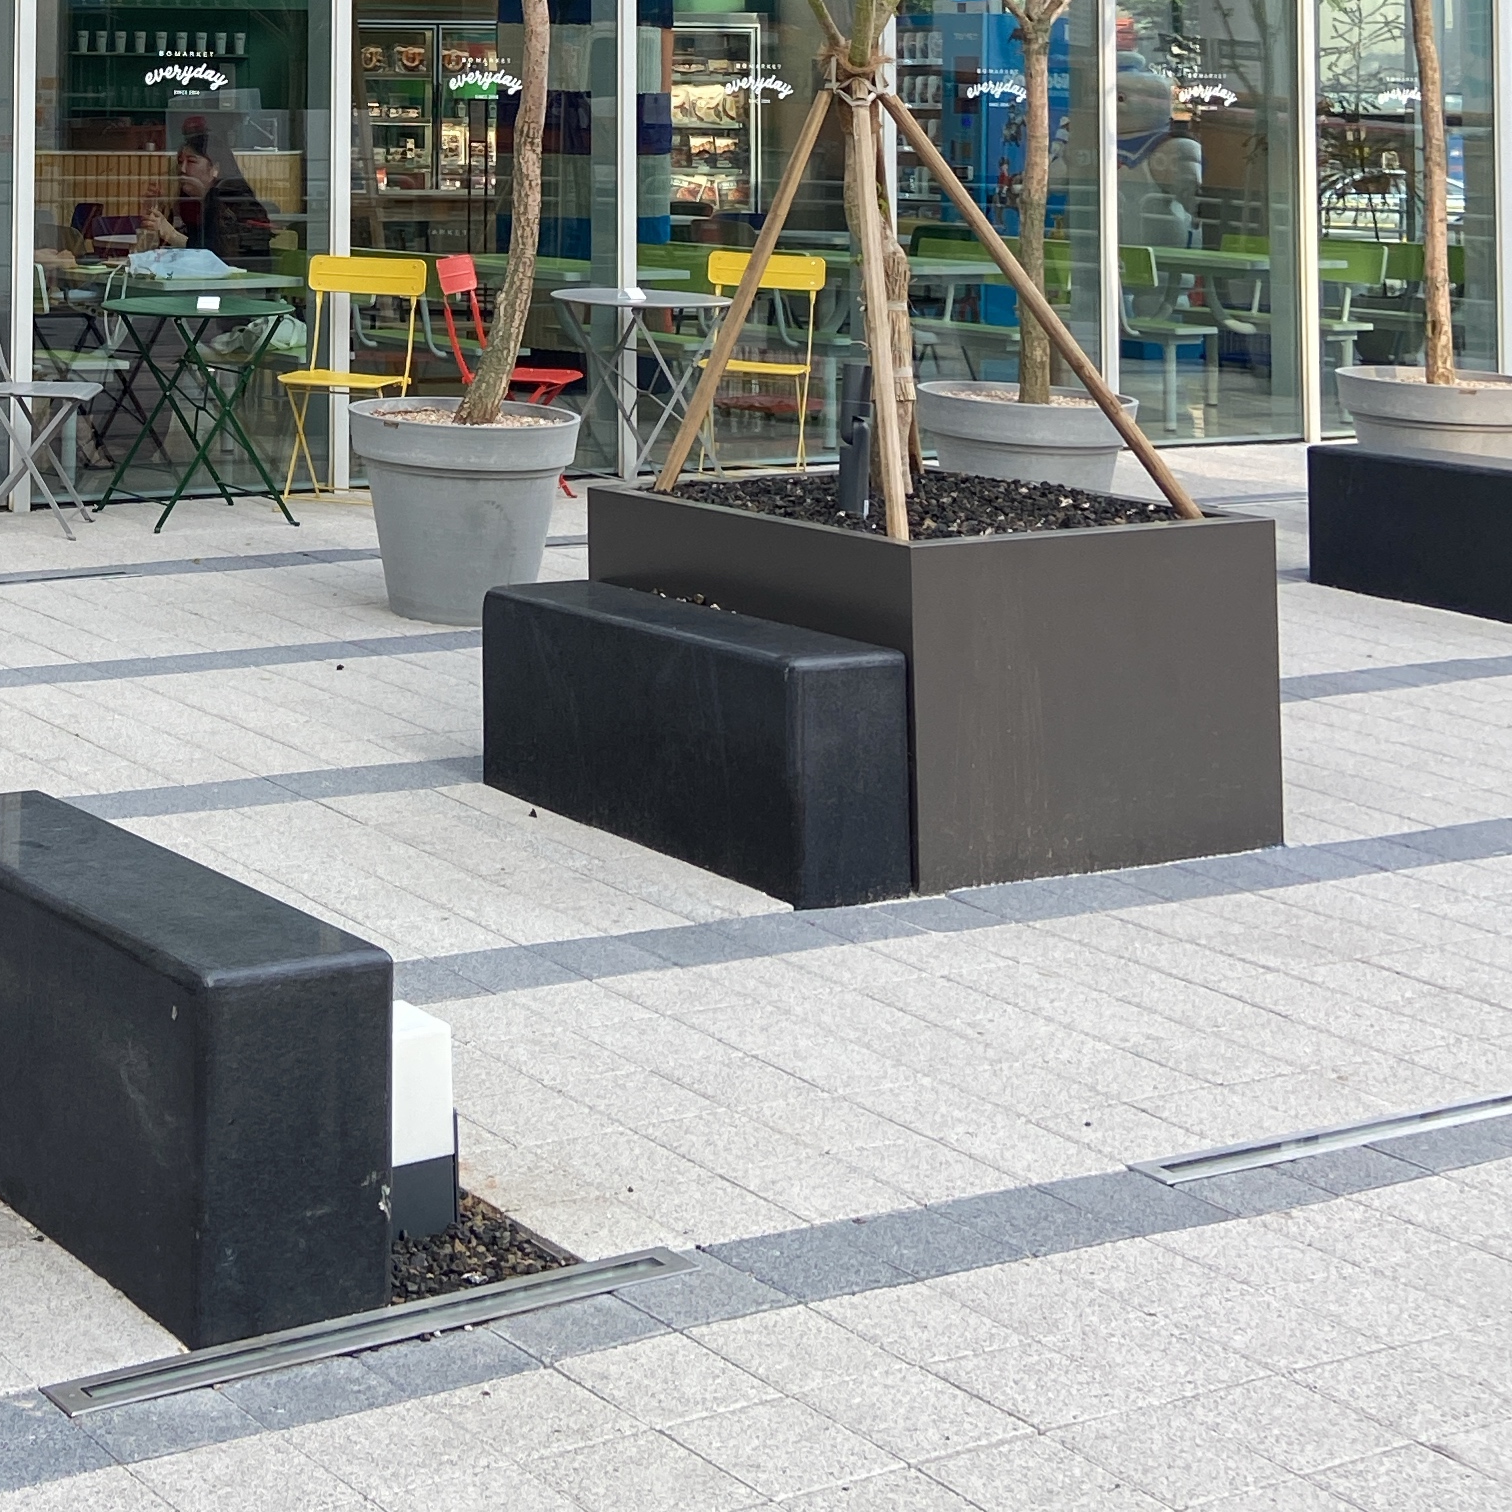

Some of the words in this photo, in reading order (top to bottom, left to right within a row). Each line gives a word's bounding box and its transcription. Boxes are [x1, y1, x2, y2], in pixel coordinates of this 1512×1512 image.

[145, 63, 228, 90] everyday
[449, 69, 523, 95] everyday
[725, 74, 794, 100] everyday
[966, 80, 1027, 103] everyday
